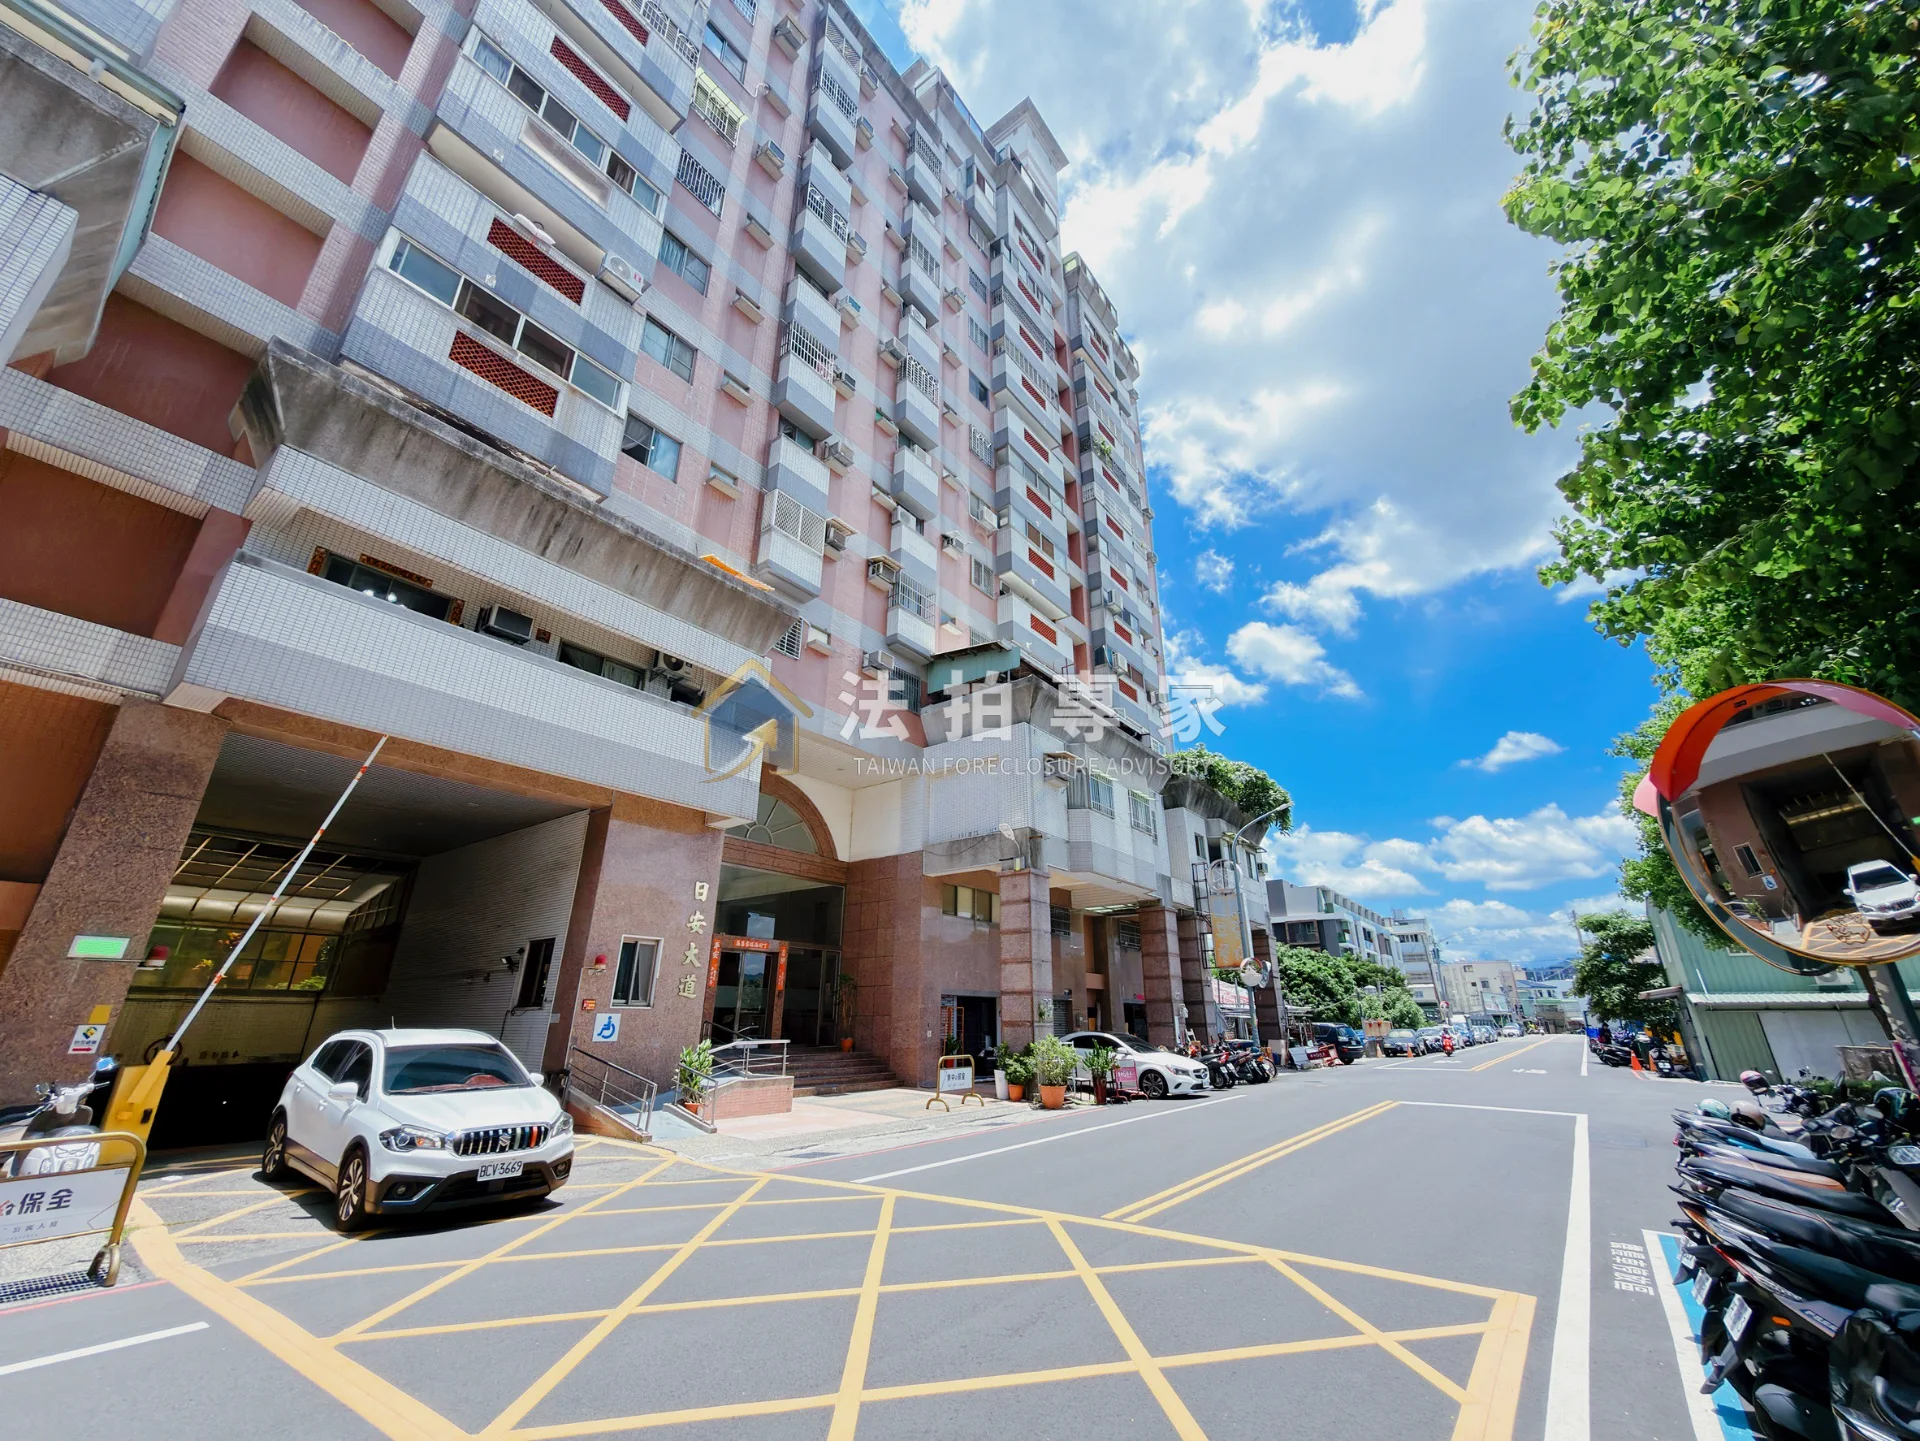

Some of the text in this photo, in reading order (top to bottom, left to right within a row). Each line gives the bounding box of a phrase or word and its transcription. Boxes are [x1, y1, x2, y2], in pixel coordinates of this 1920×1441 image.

[678, 880, 710, 1000] 日安大道
[479, 1161, 523, 1178] BCV-3669
[17, 1188, 74, 1216] 保全
